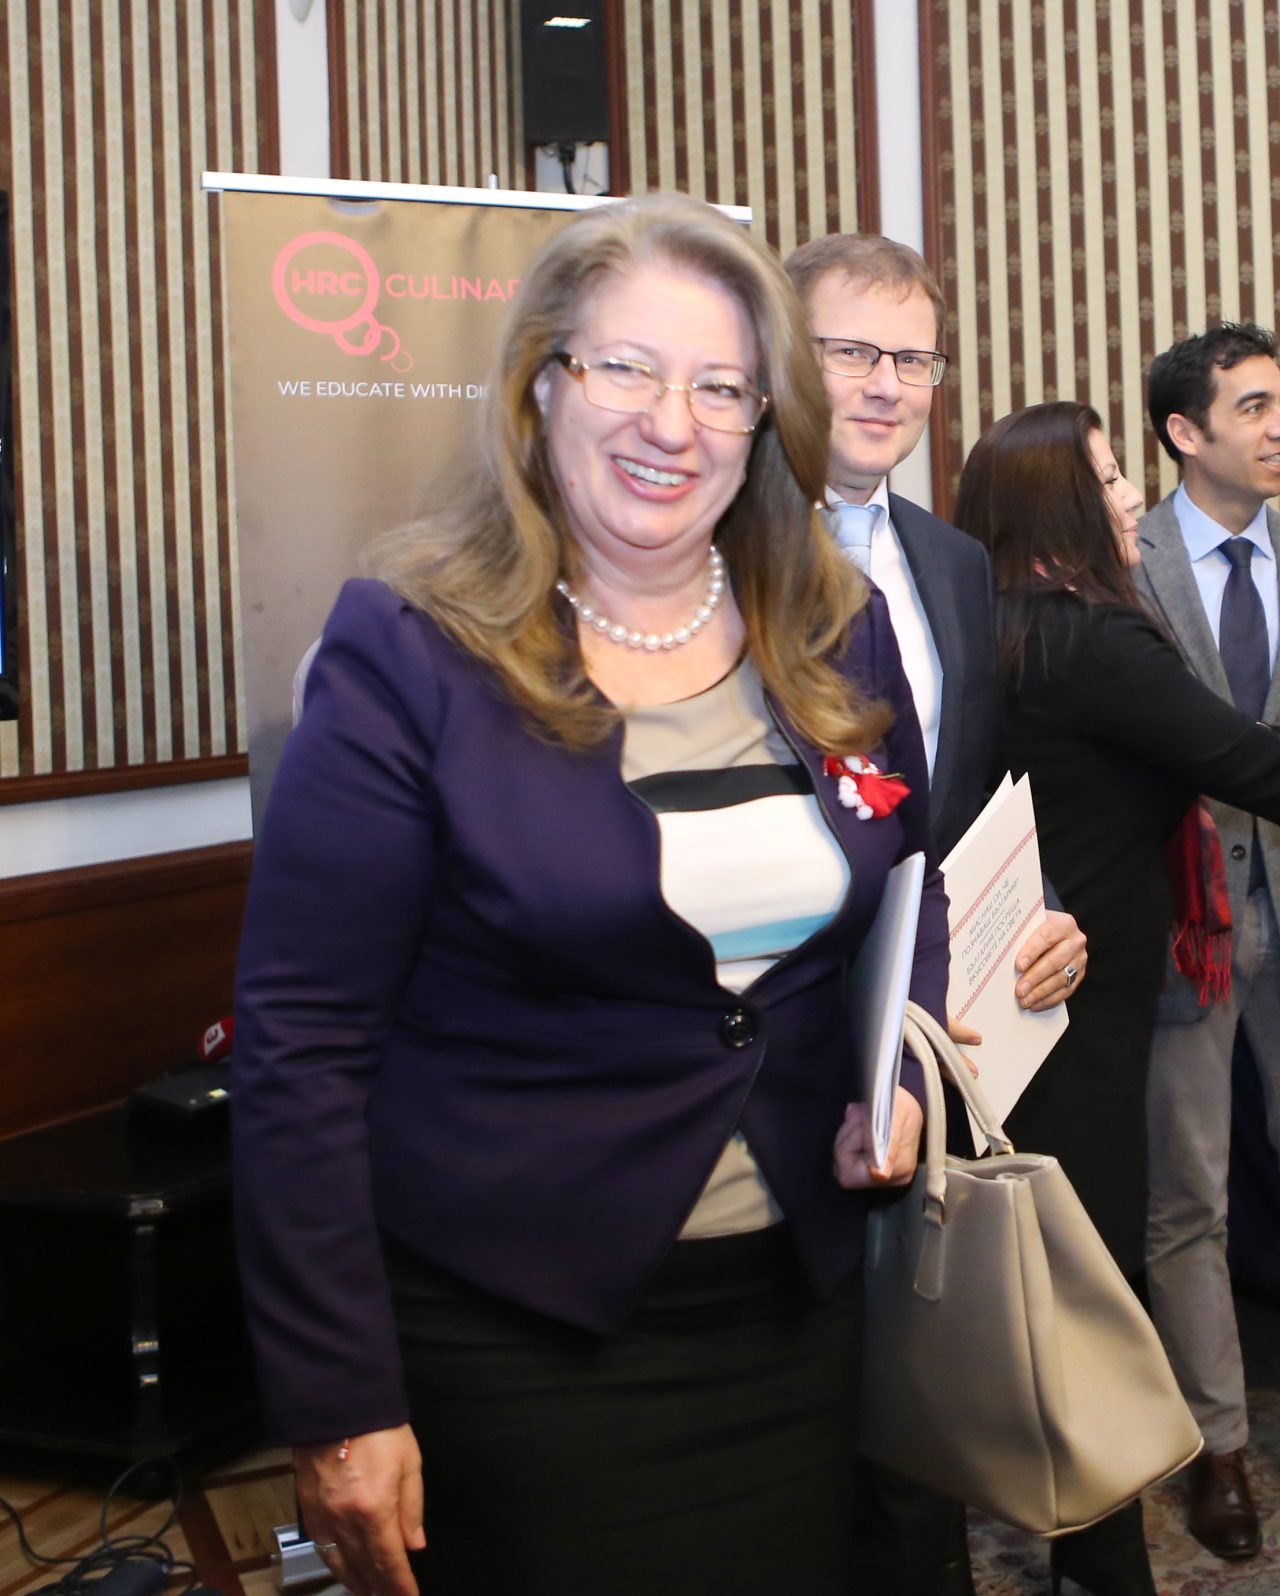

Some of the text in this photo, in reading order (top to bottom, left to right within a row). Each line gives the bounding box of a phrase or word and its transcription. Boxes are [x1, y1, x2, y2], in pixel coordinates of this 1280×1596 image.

[291, 270, 362, 296] HRC
[278, 381, 311, 396] WE
[316, 381, 405, 397] EDUCATE
[410, 383, 462, 399] WITH
